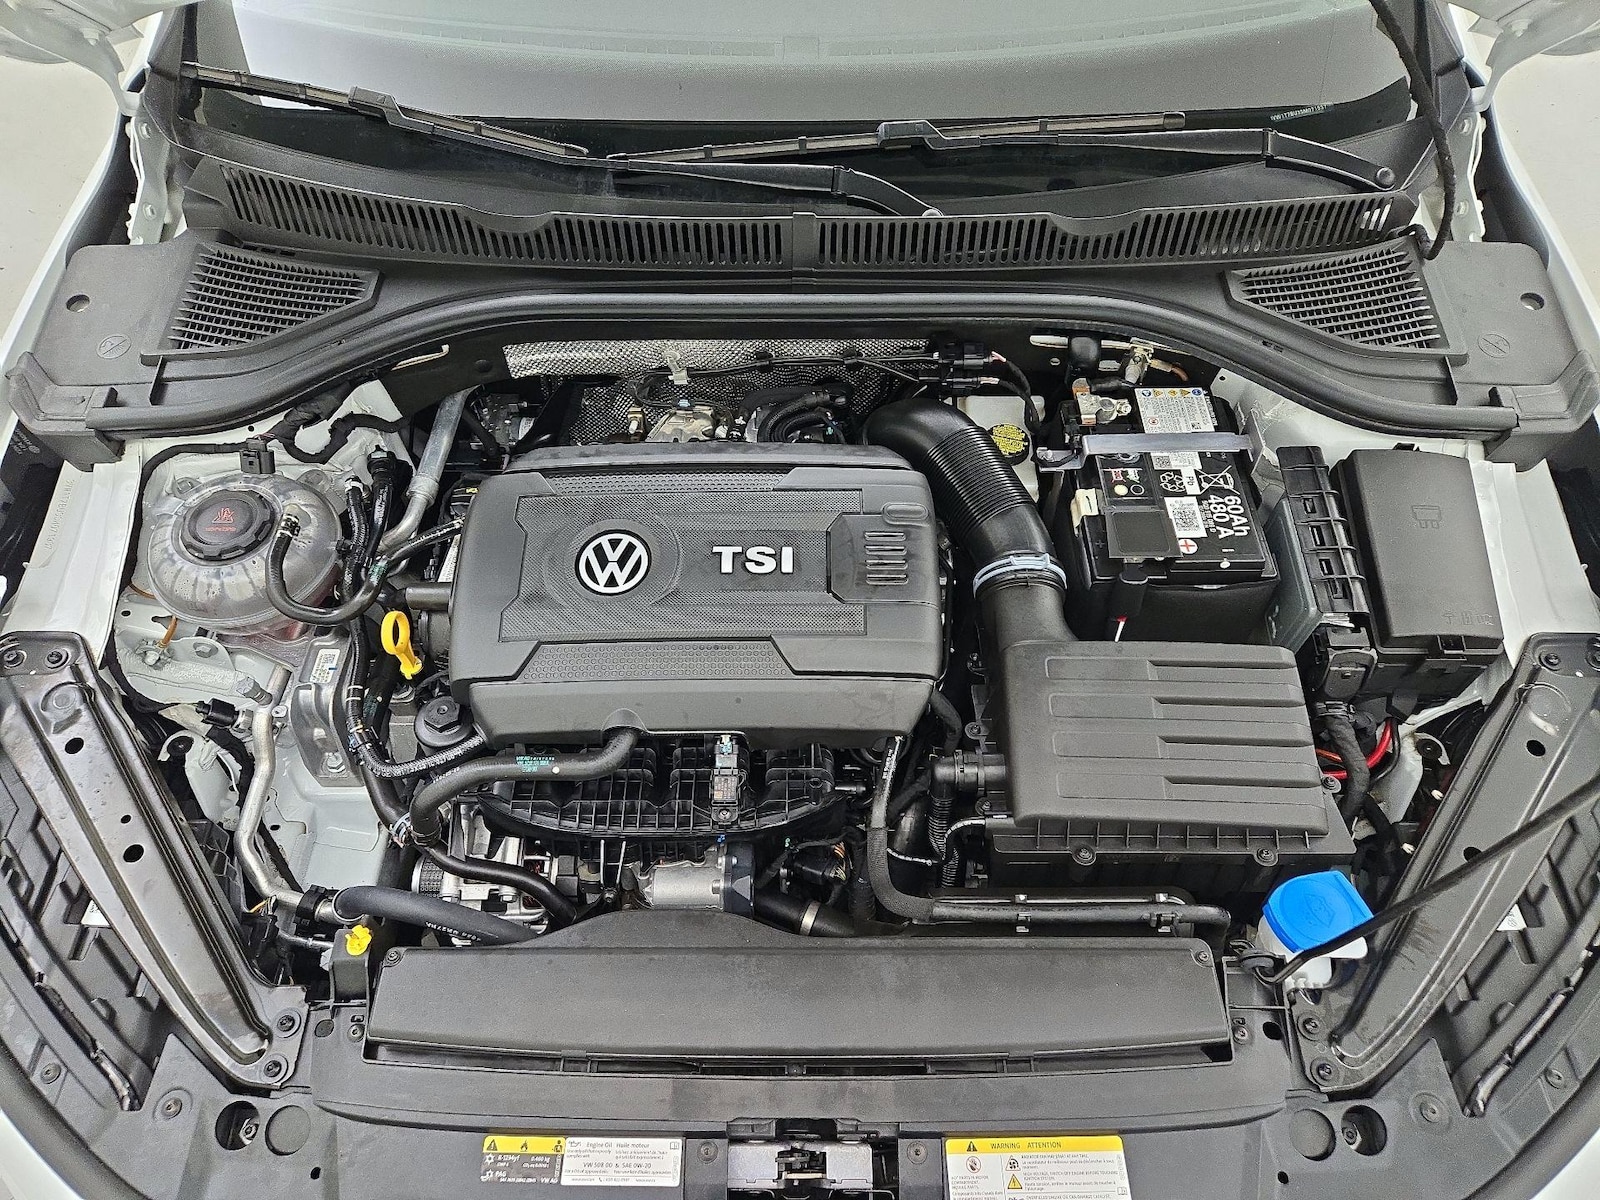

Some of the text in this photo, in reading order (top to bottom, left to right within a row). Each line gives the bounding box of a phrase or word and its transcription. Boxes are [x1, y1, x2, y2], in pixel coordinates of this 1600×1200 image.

[1186, 475, 1195, 486] Pb
[1208, 494, 1235, 540] 480 A
[1224, 495, 1251, 537] 60Ah
[712, 545, 795, 575] TSI
[586, 1141, 604, 1149] Engine
[1027, 1140, 1062, 1149] ATTENTION
